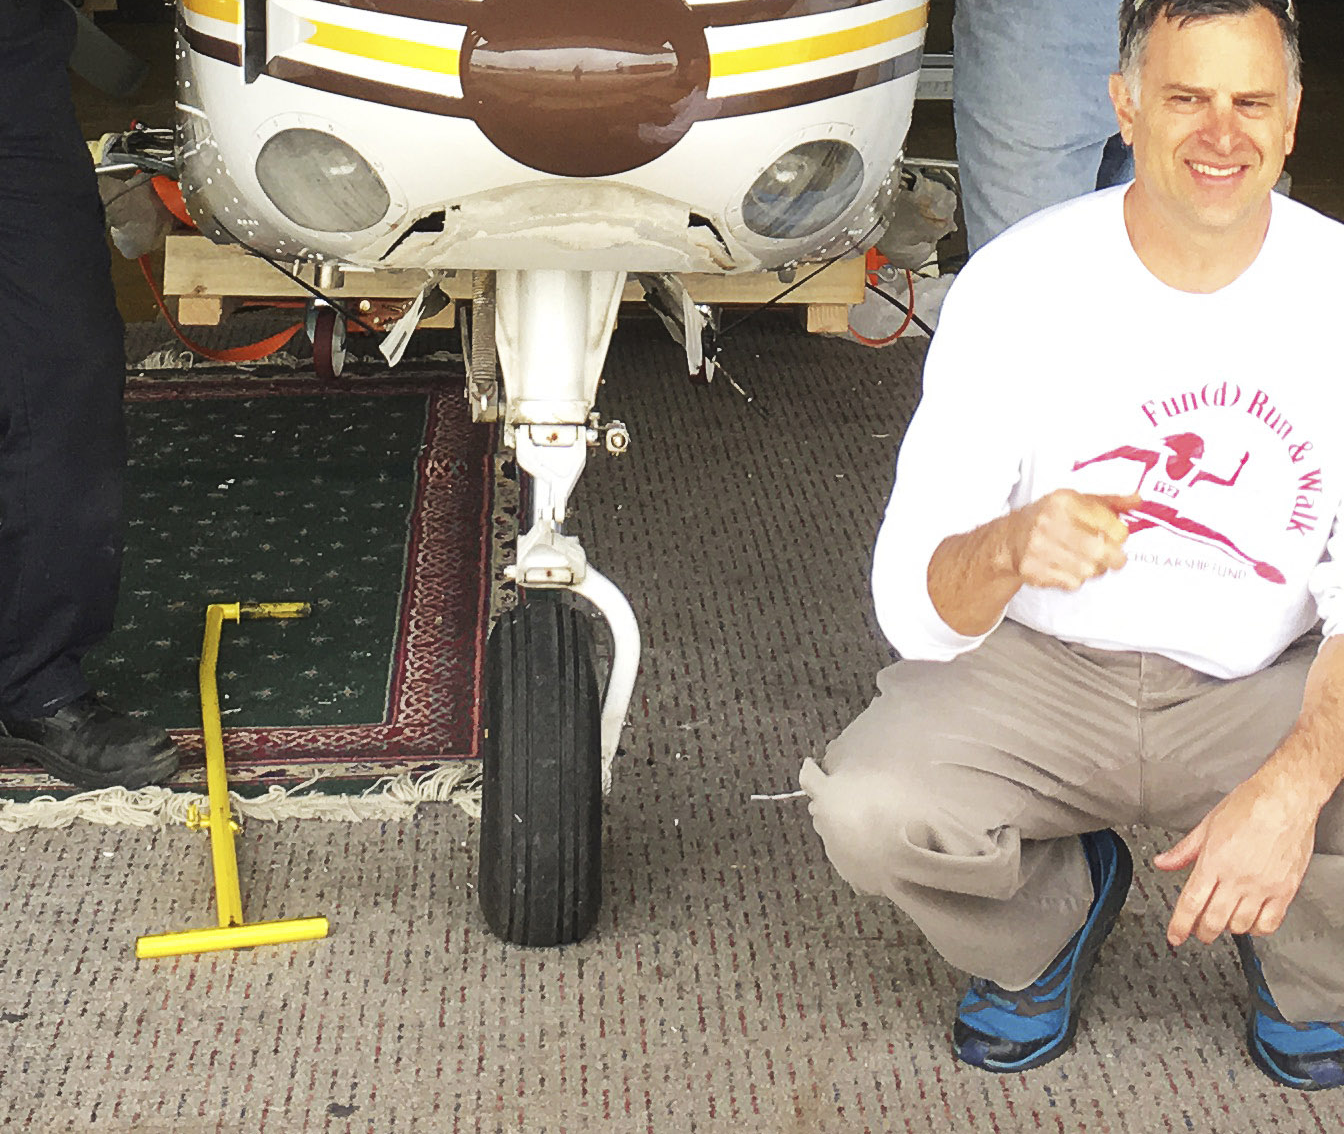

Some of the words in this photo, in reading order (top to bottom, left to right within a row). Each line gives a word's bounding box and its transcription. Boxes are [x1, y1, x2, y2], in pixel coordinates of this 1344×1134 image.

[1140, 381, 1242, 428] Fun(d)
[1247, 389, 1294, 441] Run
[1287, 440, 1314, 464] &
[1285, 467, 1323, 537] Walk
